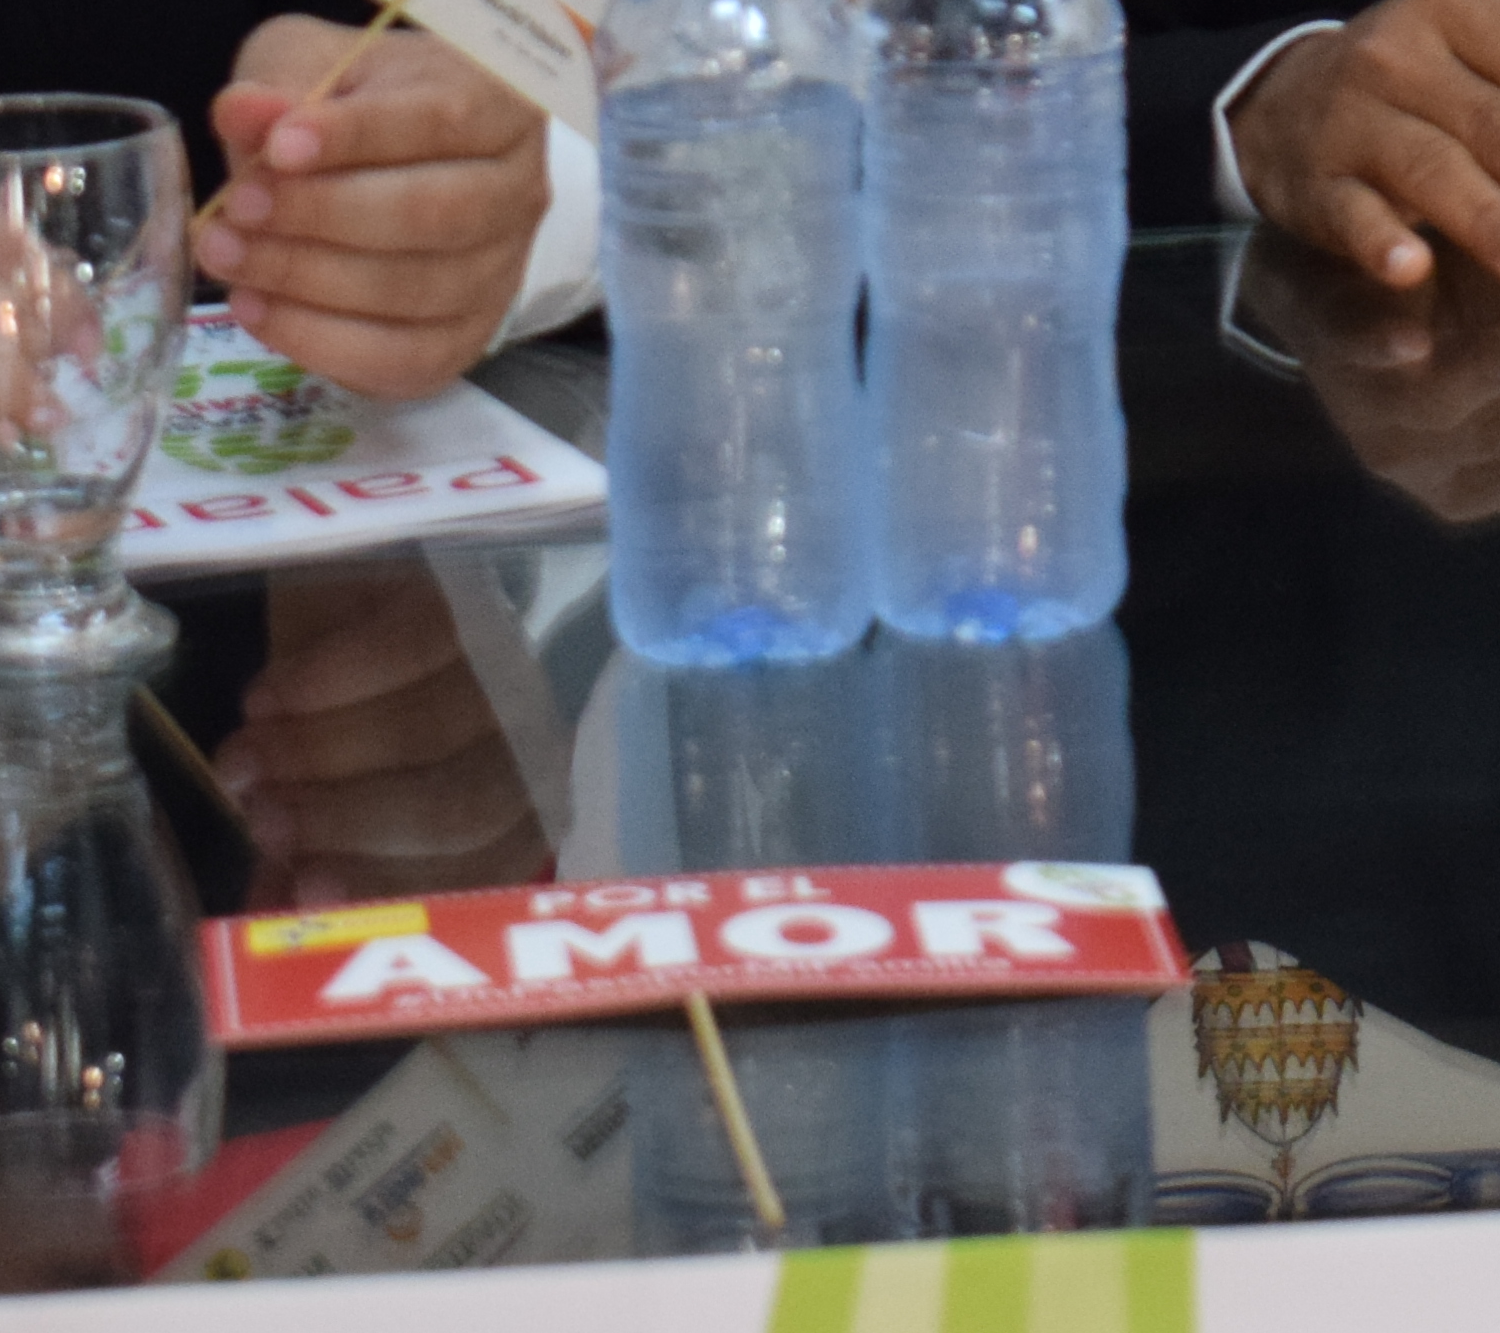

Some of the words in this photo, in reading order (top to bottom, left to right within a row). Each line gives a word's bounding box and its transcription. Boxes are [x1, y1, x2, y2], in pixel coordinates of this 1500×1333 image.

[528, 883, 717, 917] POR
[740, 873, 833, 903] EL
[318, 899, 1076, 1002] AMOR
